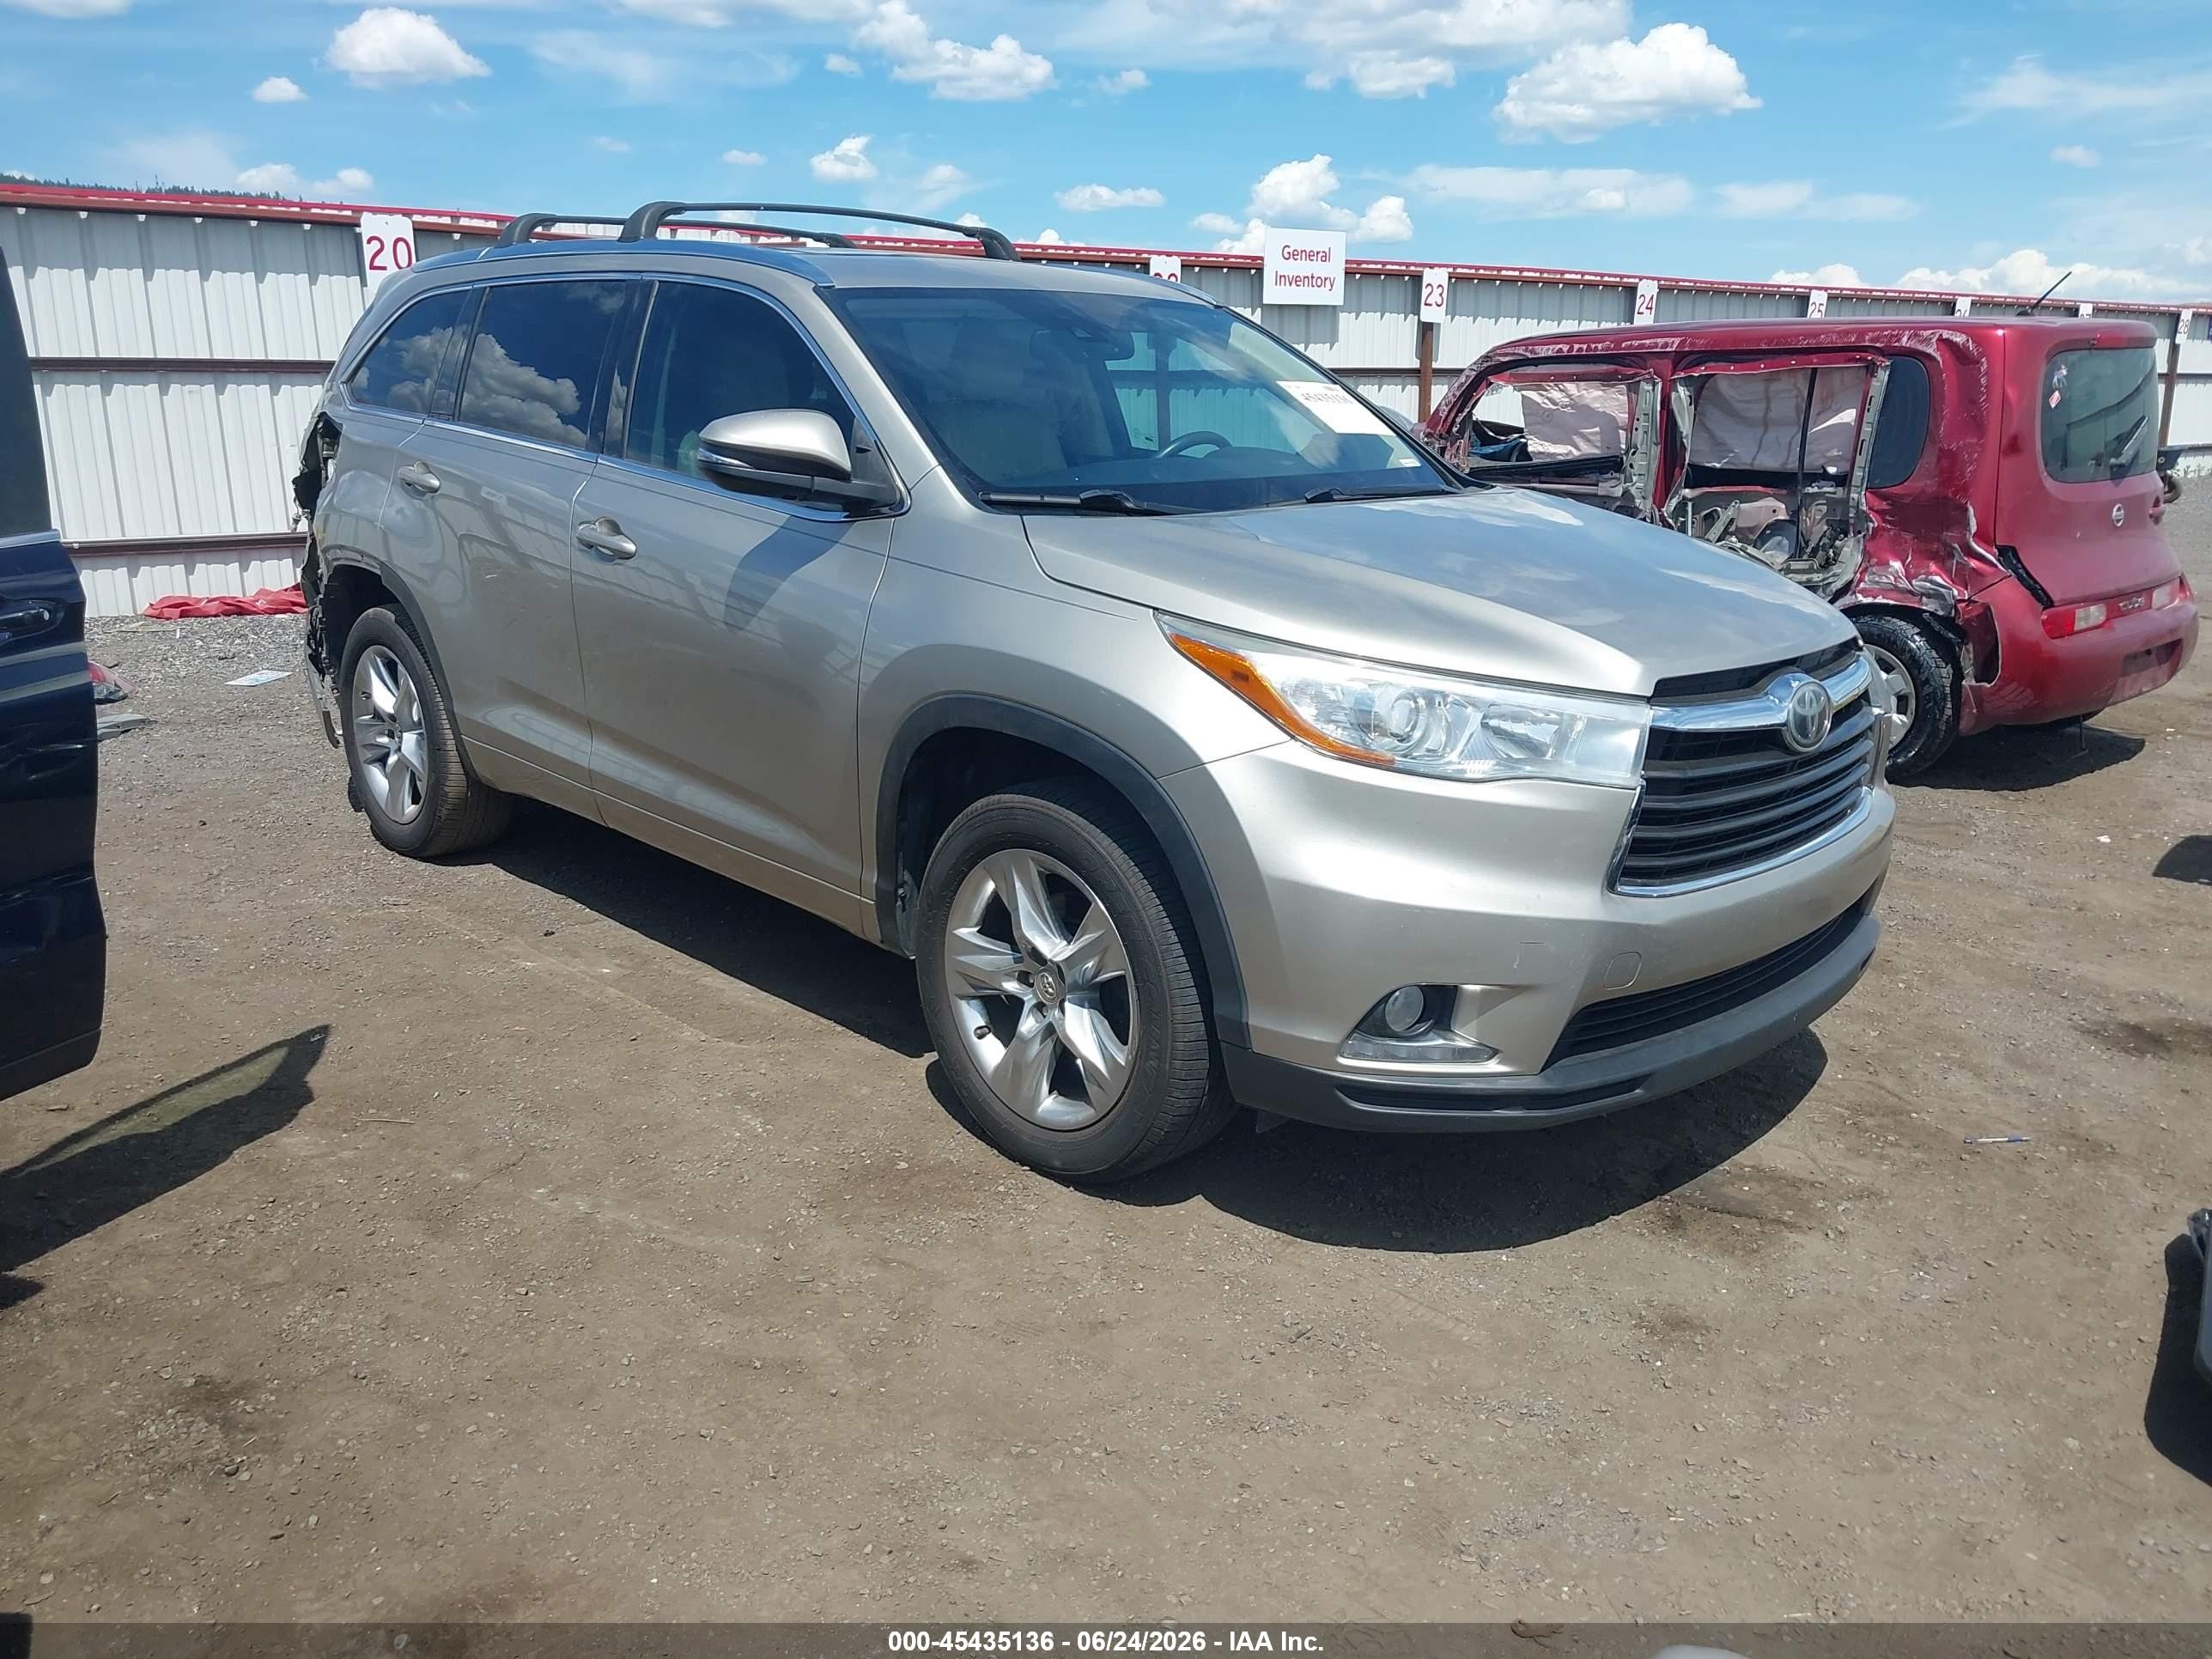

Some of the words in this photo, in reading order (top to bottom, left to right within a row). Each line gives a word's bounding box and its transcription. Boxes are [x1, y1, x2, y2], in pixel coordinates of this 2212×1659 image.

[366, 235, 412, 270] 20
[1281, 244, 1331, 263] General
[1274, 270, 1336, 292] Inventory
[1424, 283, 1444, 307] 23
[1637, 294, 1655, 315] 24
[1809, 301, 1825, 319] 25
[2178, 319, 2191, 335] 28
